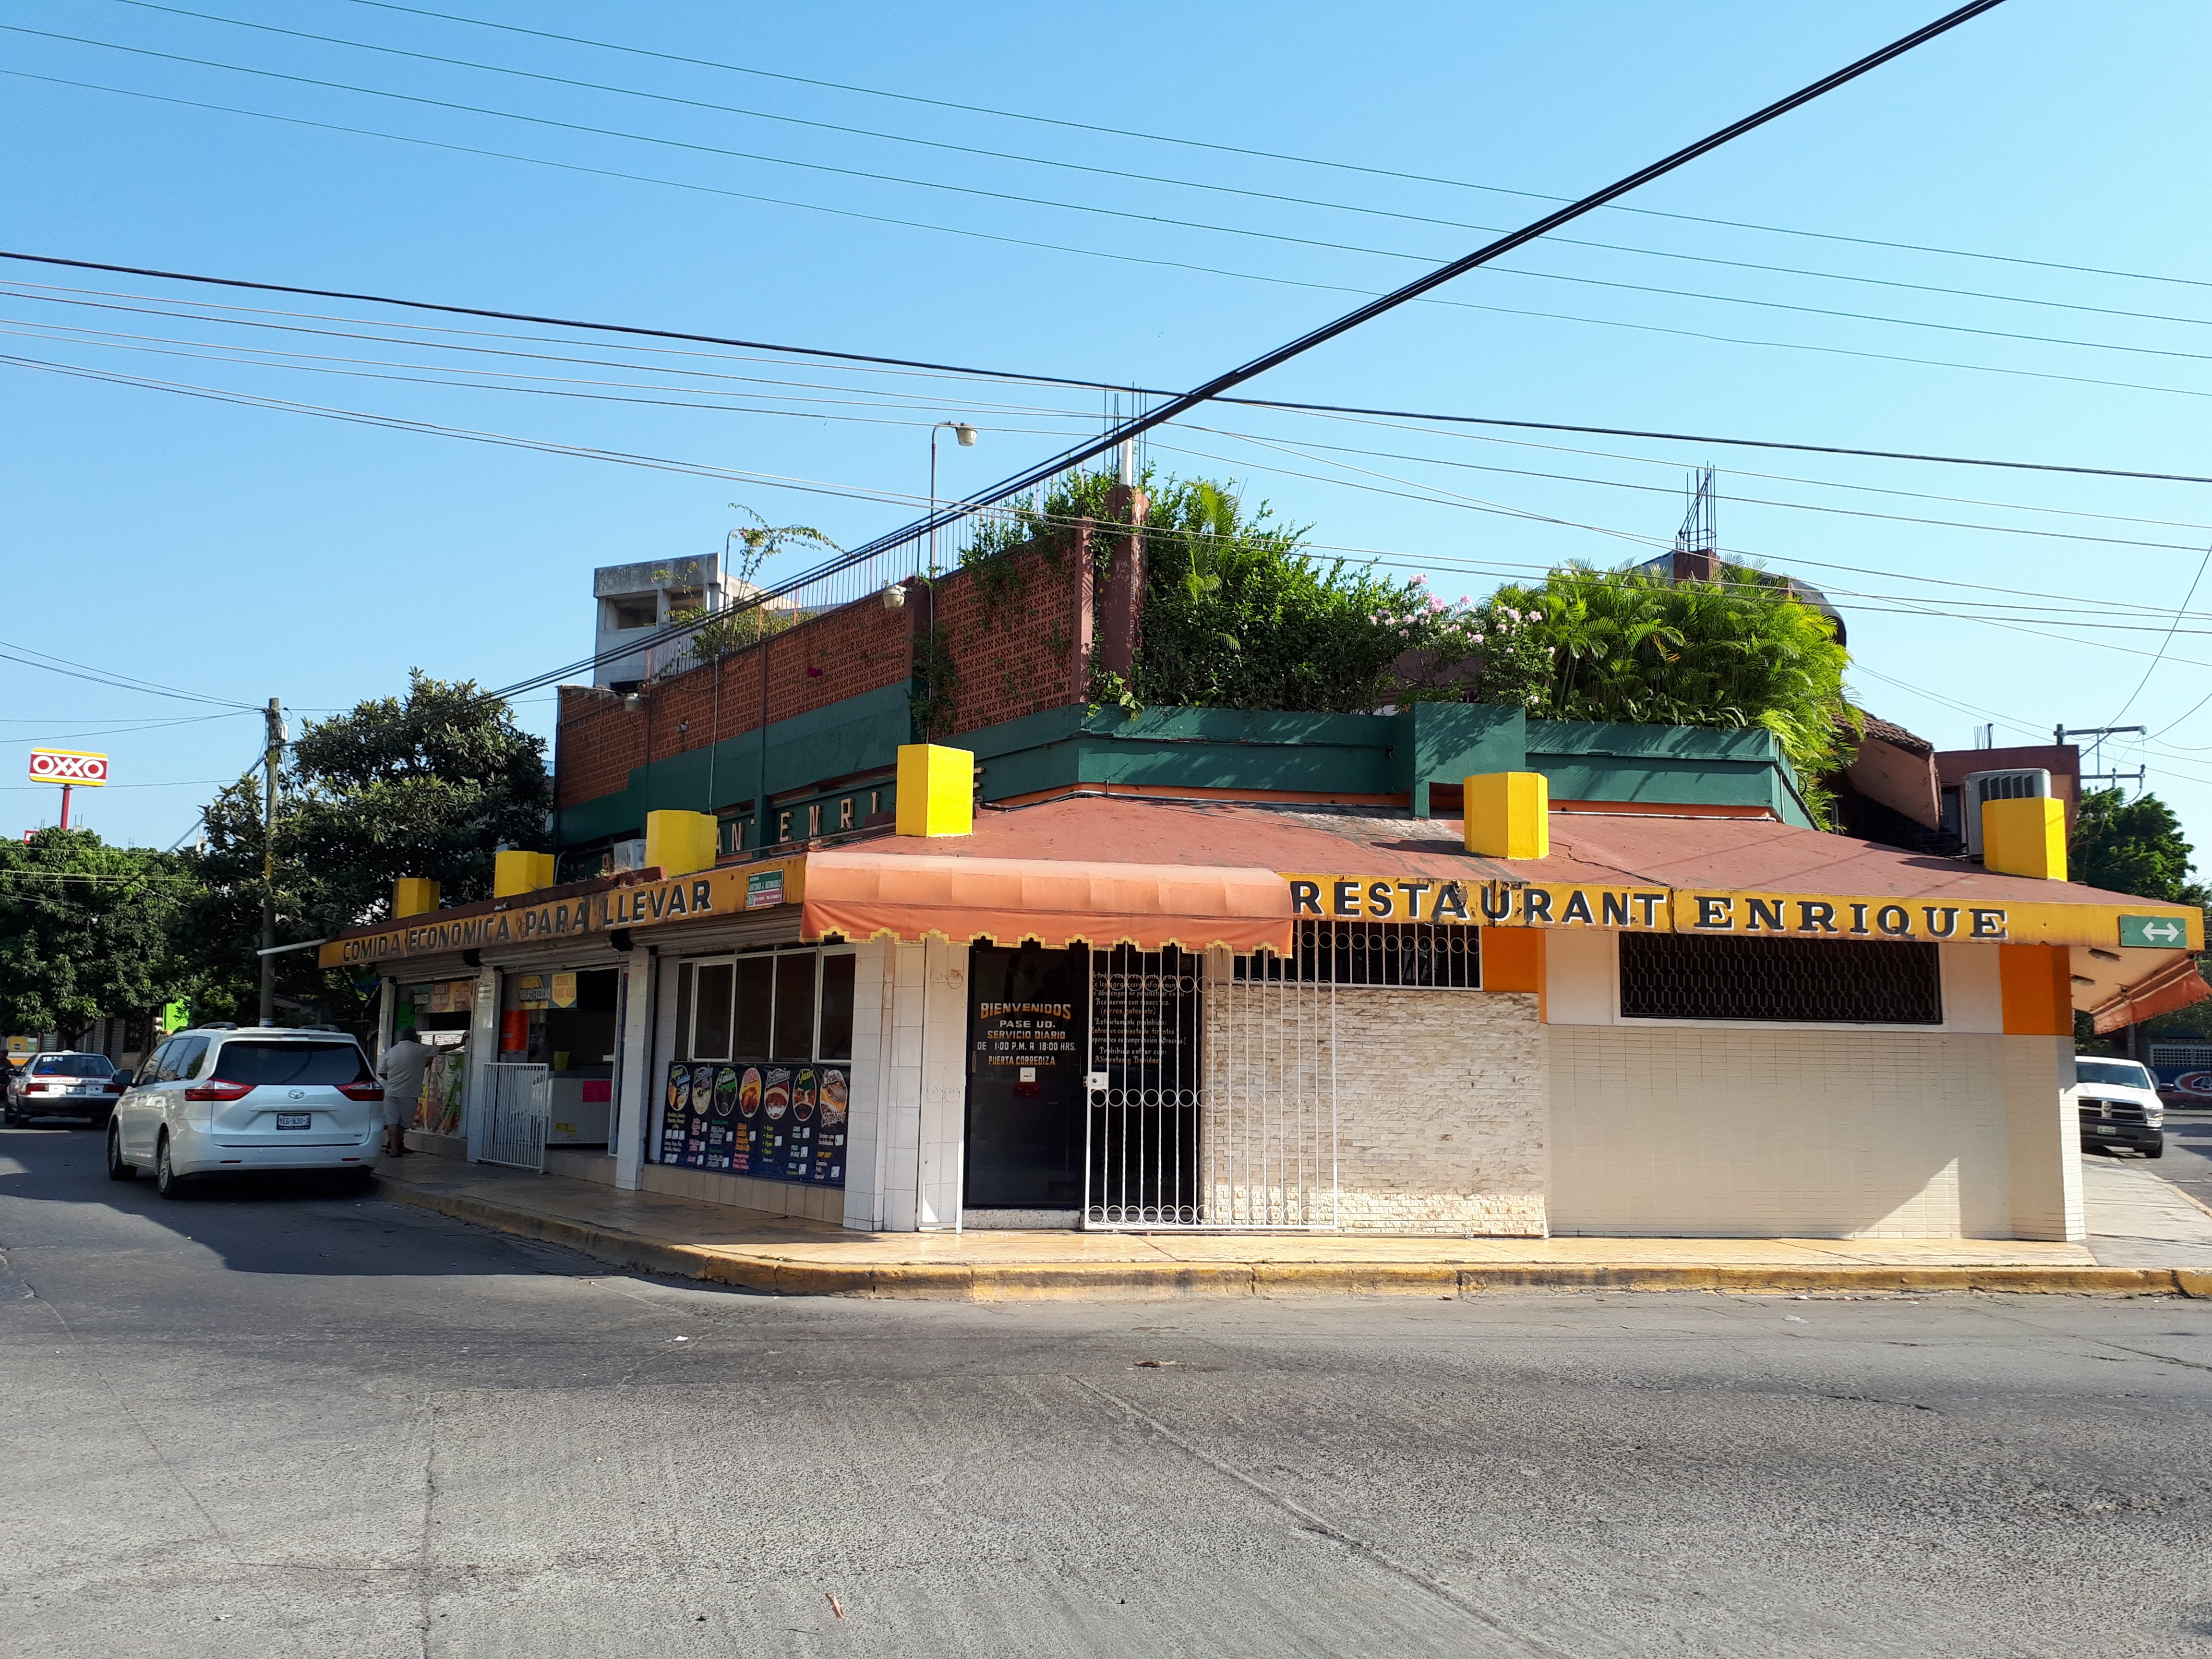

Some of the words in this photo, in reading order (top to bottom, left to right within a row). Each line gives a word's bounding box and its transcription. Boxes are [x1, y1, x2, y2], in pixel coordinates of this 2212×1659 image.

[33, 756, 104, 779] OXXO
[1290, 880, 1667, 928] RESTAURANT
[1694, 896, 2009, 940] ENRIQUE
[343, 934, 402, 962] COMIDA
[409, 915, 511, 952] ECONOMICA
[525, 902, 589, 938] PARA
[602, 879, 712, 928] LLEVAR
[1098, 989, 1126, 998] absenga
[980, 1002, 1071, 1020] BIENVENIDOS
[1100, 1006, 1124, 1016] (prros,
[999, 1020, 1031, 1028] PASE
[1036, 1020, 1056, 1028] UD.
[987, 1030, 1031, 1039] SERVICIO
[1034, 1031, 1066, 1040] DIARIO
[977, 1041, 987, 1051] DE
[994, 1041, 1009, 1051] 1:00
[1011, 1041, 1027, 1051] P.M.
[1029, 1041, 1034, 1051] A
[1039, 1041, 1058, 1051] 18:00
[1060, 1042, 1076, 1051] HRS.
[988, 1056, 1014, 1065] PUERTA
[1016, 1056, 1056, 1066] CORREDIZA
